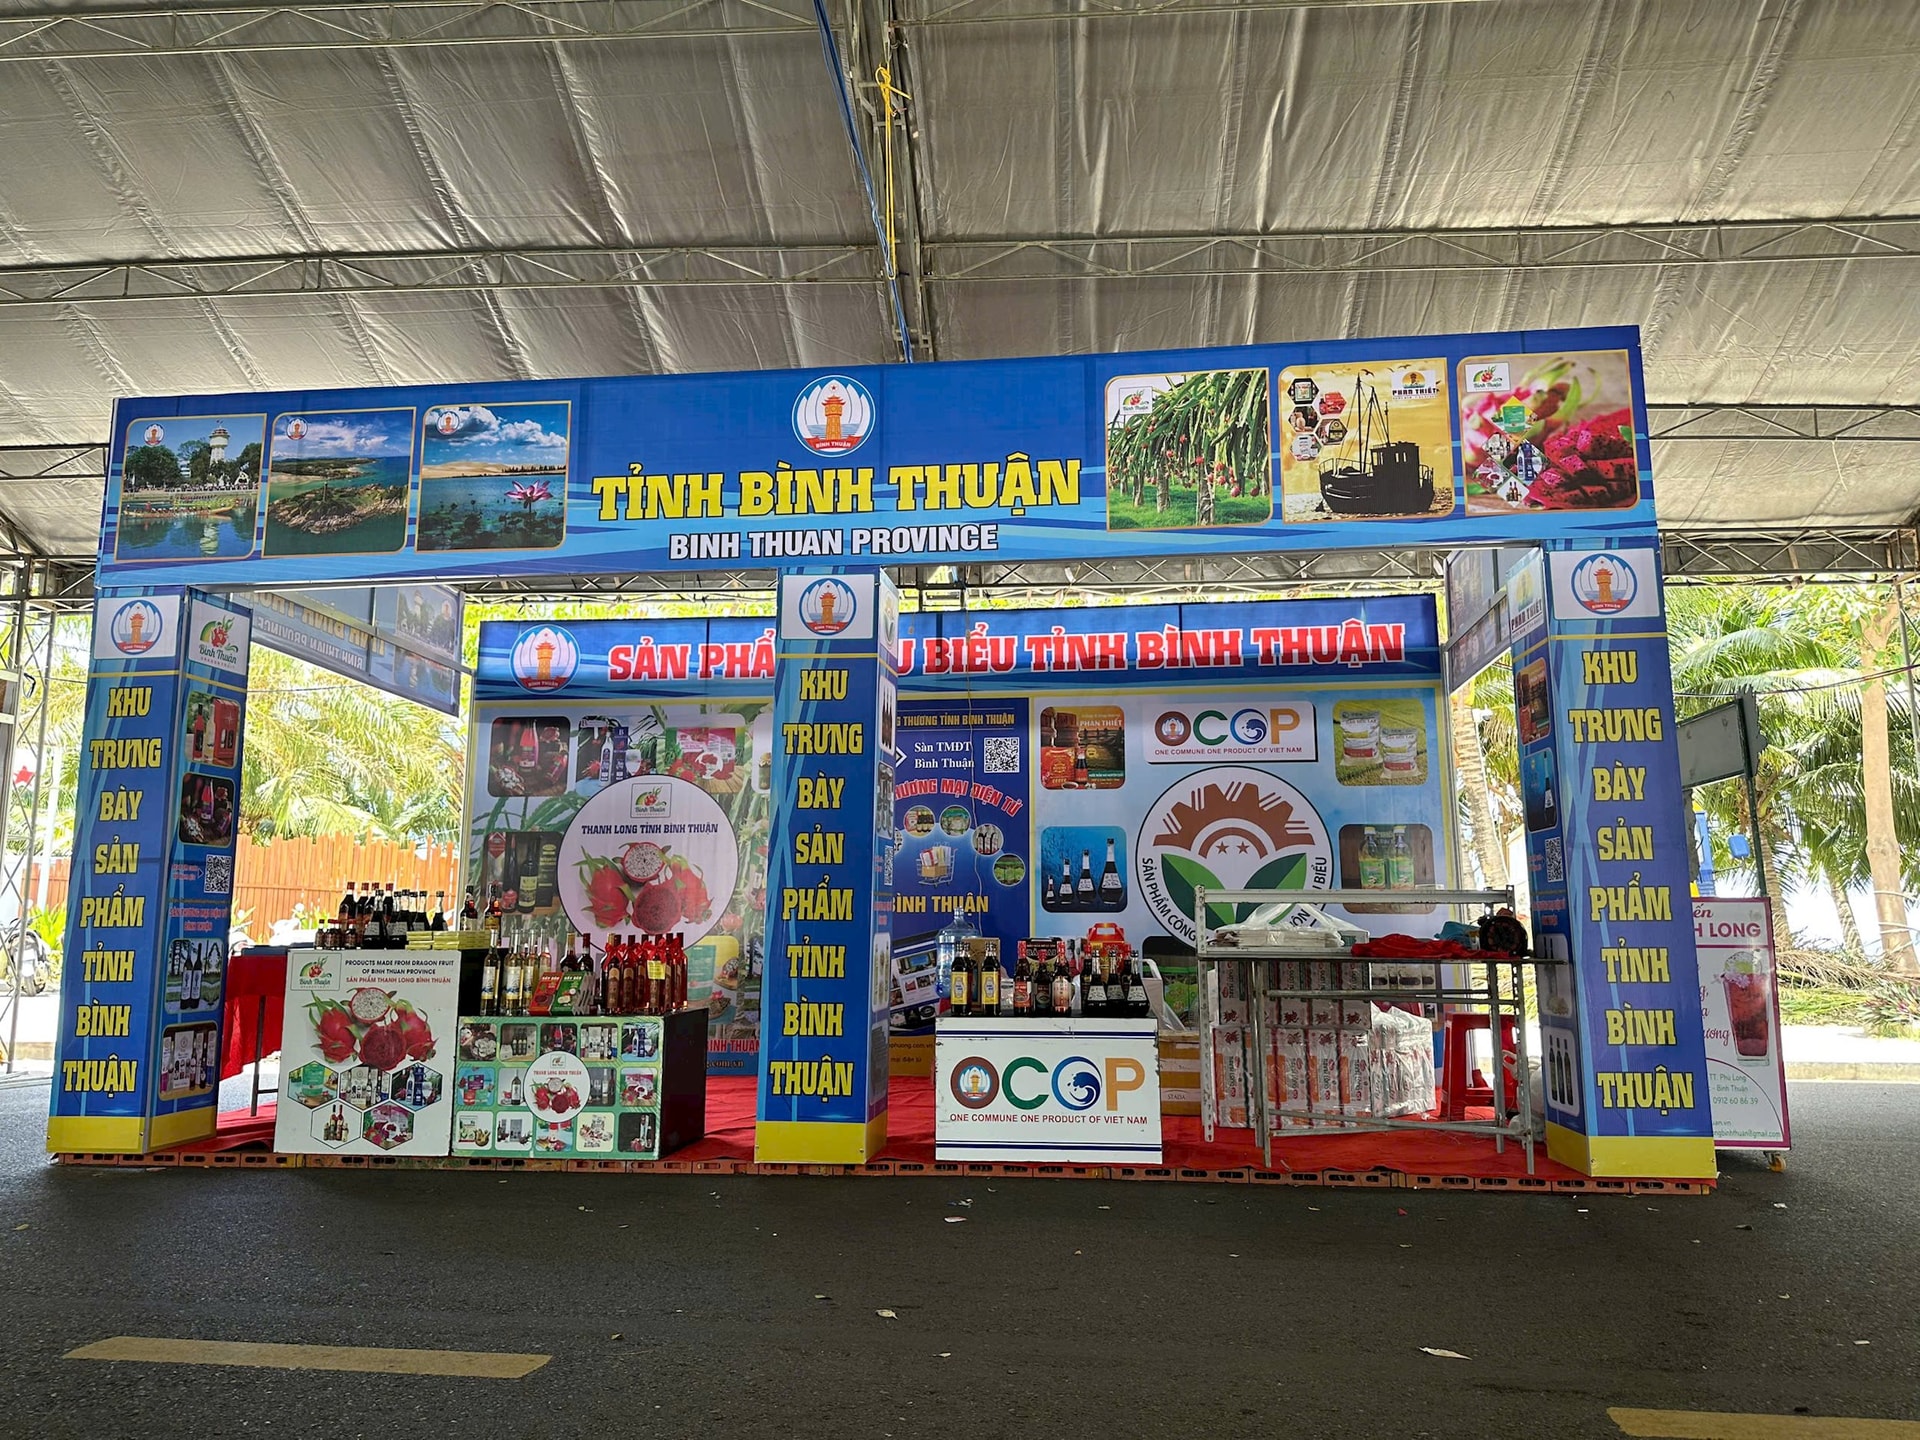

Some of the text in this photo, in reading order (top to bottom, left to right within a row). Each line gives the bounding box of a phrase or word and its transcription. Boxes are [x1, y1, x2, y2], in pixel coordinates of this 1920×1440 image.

[592, 452, 1082, 521] TỈNH BÌNH THUẬN
[669, 523, 999, 560] BINH THUAN PROVINCE
[607, 635, 691, 682] SẢN
[923, 622, 1019, 675] BIỂU
[1025, 626, 1129, 673] TỈNH
[1135, 623, 1244, 669] BÌNH
[1250, 617, 1406, 668] THUẬN
[800, 669, 848, 701] KHU
[1582, 650, 1638, 685] KHU
[107, 687, 152, 718] KHU
[986, 712, 1015, 727] THUẬN
[783, 722, 863, 755] TRƯNG
[1154, 708, 1300, 747] OCOP
[1568, 708, 1663, 743] TRƯNG
[90, 738, 162, 770] TRƯNG
[914, 741, 972, 752] Sàn TMĐT
[914, 758, 975, 770] Bình Thuận
[797, 771, 845, 810] BÀY
[941, 778, 969, 799] MẠI
[1592, 760, 1646, 802] BÀY
[99, 784, 143, 822] BÀY
[582, 821, 718, 835] THANH LONG TỈNH BÌNH THUẬN
[795, 824, 845, 865] SẢN
[1597, 818, 1654, 862] SẢN
[94, 836, 140, 875] SẢN
[1312, 856, 1327, 886] BIỂU
[80, 884, 145, 928] PHẨM
[782, 874, 854, 921] PHẨM
[1142, 857, 1196, 941] SẢN PHẨM CÔNG
[1588, 871, 1673, 922] PHẨM
[1710, 922, 1761, 938] LONG
[82, 942, 136, 982] TỈNH
[787, 935, 847, 979] TỈNH
[1601, 937, 1671, 984] TỈNH
[75, 999, 130, 1037] BÌNH
[782, 996, 844, 1037] BÌNH
[1605, 1002, 1676, 1046] BÌNH
[63, 1053, 137, 1098] THUẬN
[769, 1054, 854, 1102] THUẬN
[950, 1055, 1146, 1111] OCOP
[1597, 1065, 1695, 1116] THUẬN
[1732, 1074, 1747, 1083] Long
[950, 1113, 1148, 1125] ONE COMMUNE ONE PRODUCT OF VIET NAM
